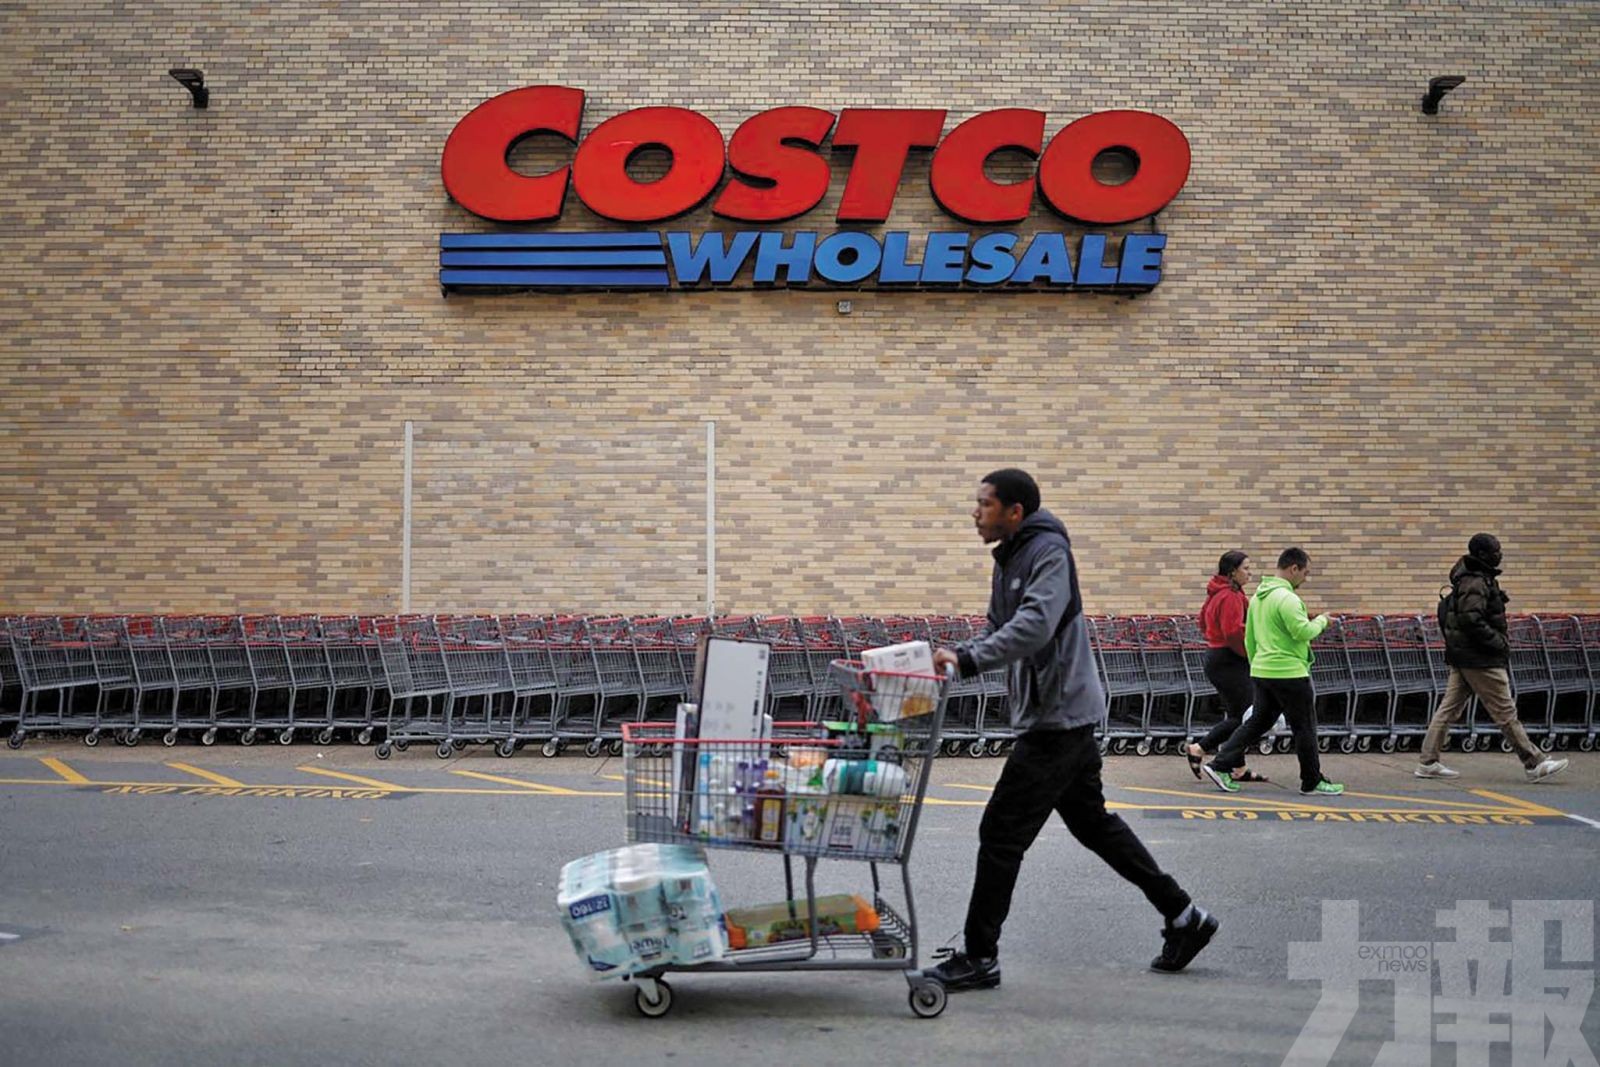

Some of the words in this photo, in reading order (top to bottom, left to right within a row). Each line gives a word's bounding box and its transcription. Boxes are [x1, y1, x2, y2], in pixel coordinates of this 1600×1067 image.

[441, 85, 1192, 223] COSTCO
[667, 231, 1166, 287] WHOLESALE
[1181, 808, 1259, 820] NO
[1276, 810, 1534, 826] PARKING
